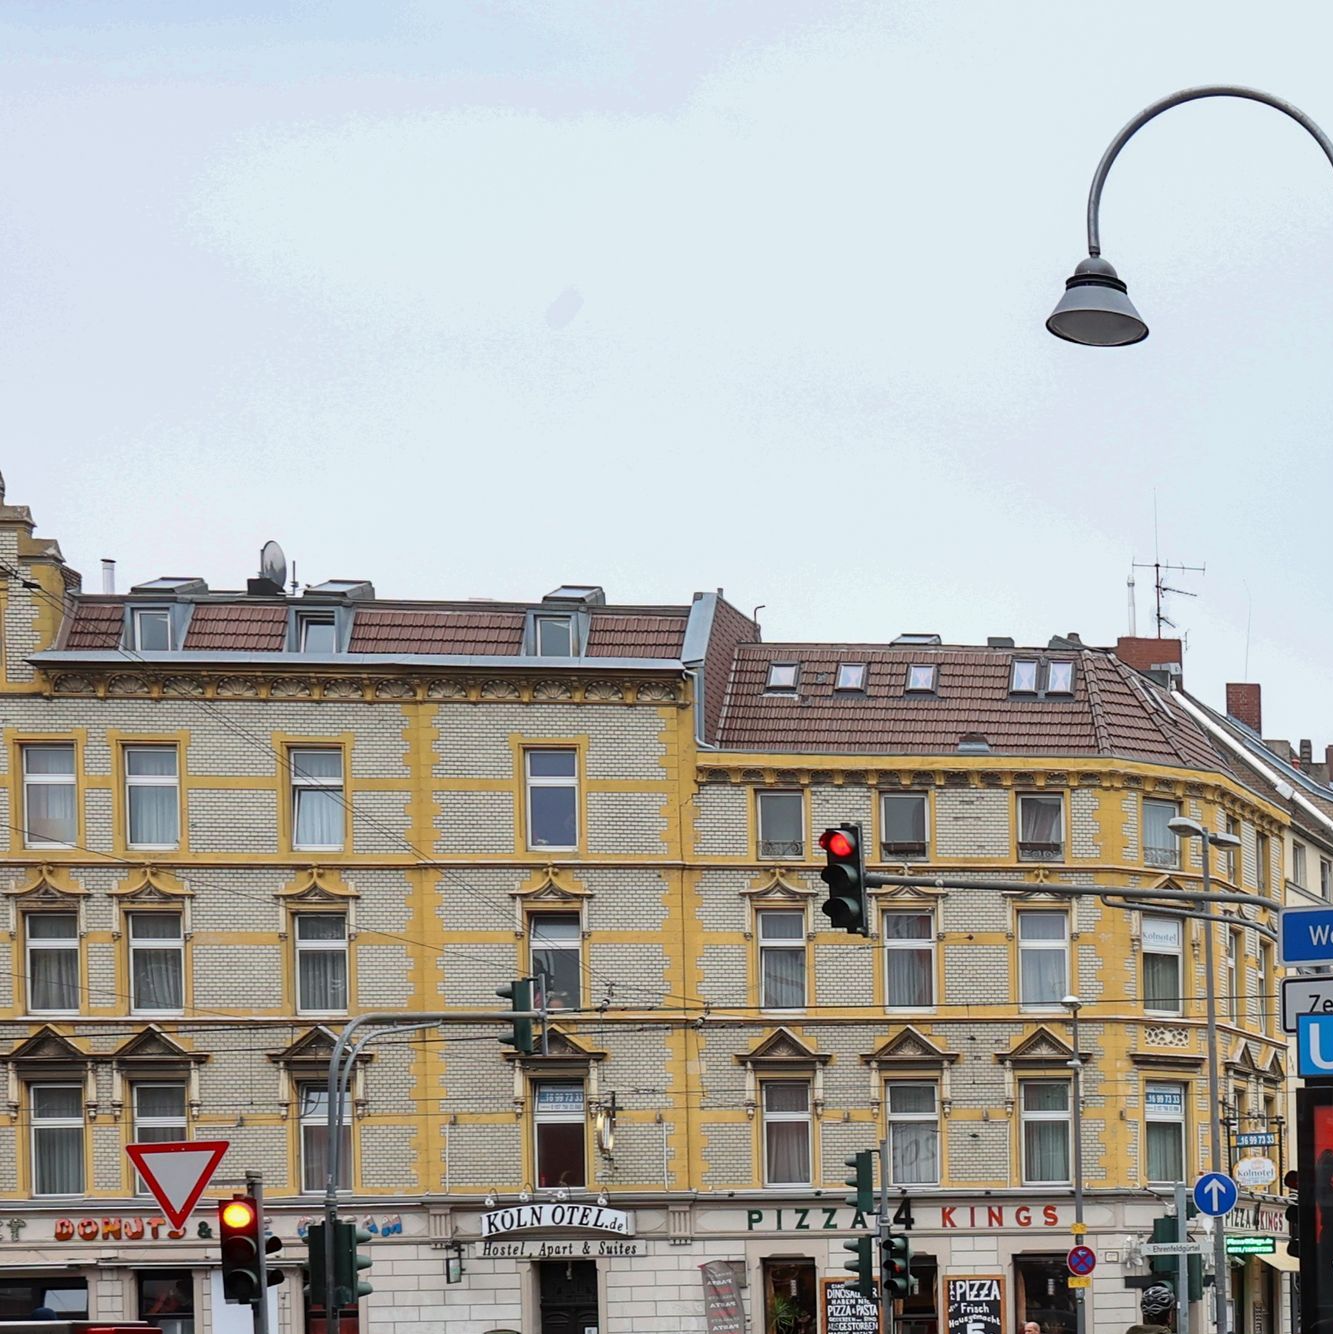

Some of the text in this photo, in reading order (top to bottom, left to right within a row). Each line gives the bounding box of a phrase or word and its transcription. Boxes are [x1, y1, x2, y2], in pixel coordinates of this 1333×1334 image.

[1249, 1134, 1274, 1144] 99 73 33
[486, 1205, 543, 1235] KÖLN
[748, 1207, 868, 1230] PIZZA
[893, 1196, 915, 1230] 4
[942, 1205, 1059, 1228] KINGS
[1260, 1210, 1284, 1231] KINGS
[197, 1220, 212, 1239] &
[539, 1241, 573, 1258] Apart
[582, 1242, 591, 1255] &
[599, 1241, 637, 1256] Suites
[955, 1279, 1001, 1301] PIZZA
[827, 1304, 852, 1317] PIZZA
[856, 1304, 878, 1317] PASTA
[960, 1302, 990, 1314] Frisch
[828, 1322, 879, 1331] AUSGESTORBEN
